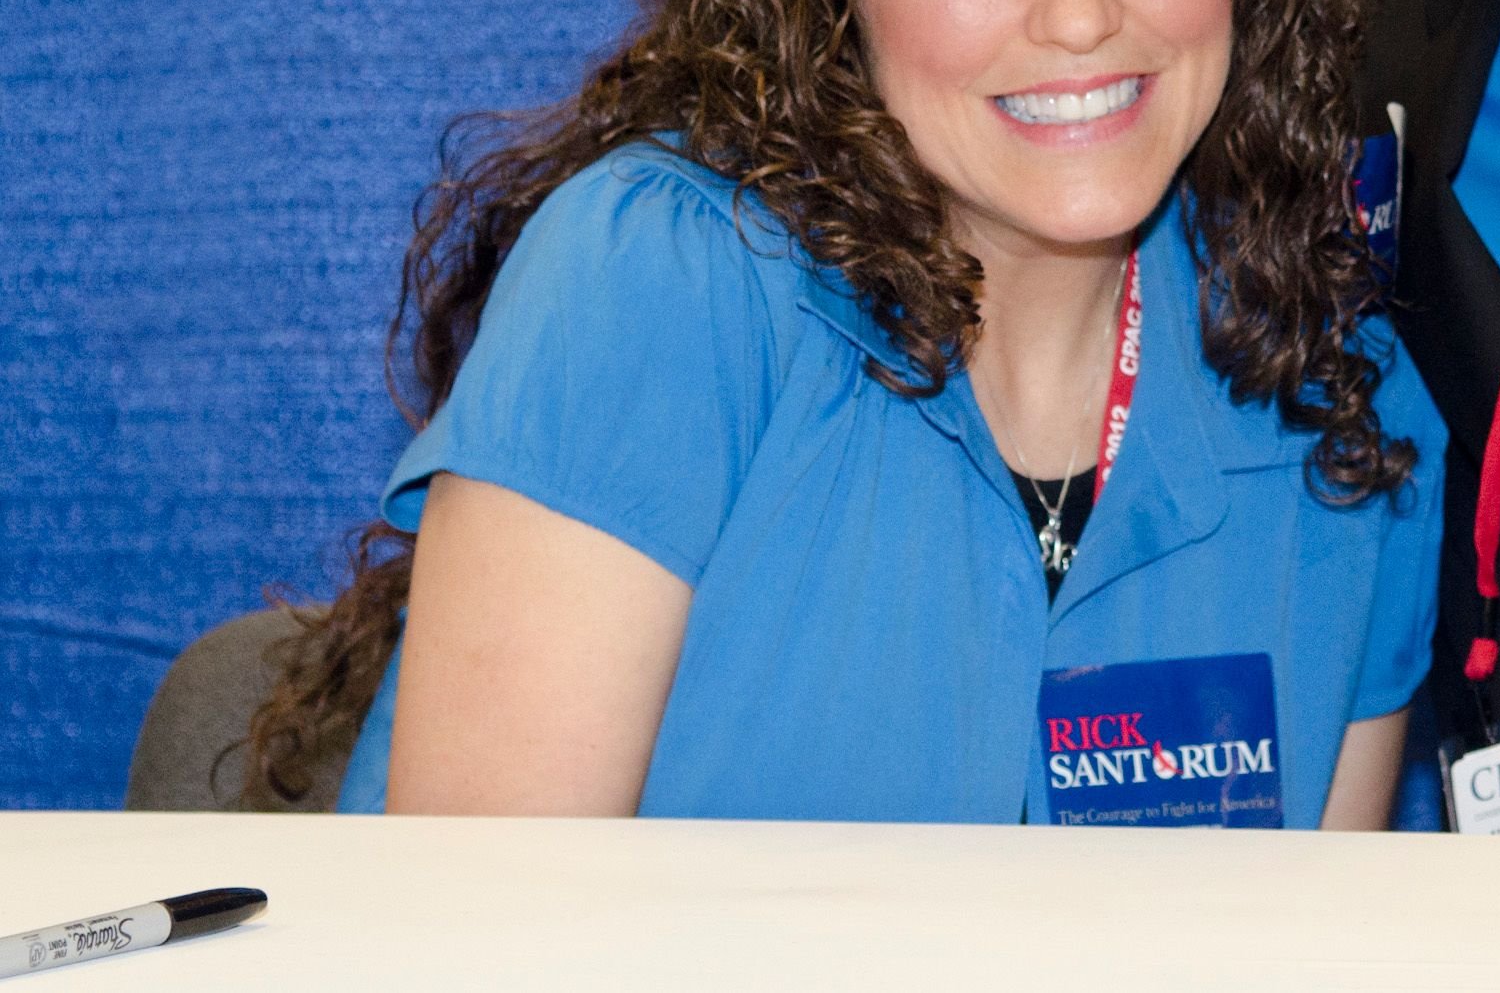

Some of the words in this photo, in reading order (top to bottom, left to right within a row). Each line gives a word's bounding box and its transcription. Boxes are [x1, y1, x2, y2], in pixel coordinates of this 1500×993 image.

[1119, 307, 1143, 376] CPAC
[1047, 713, 1147, 752] RICK
[1051, 739, 1275, 790] SANTORUM
[1058, 810, 1085, 826] The
[1087, 807, 1143, 824] Courage
[48, 938, 68, 950] POINT
[73, 917, 134, 956] Sharpie
